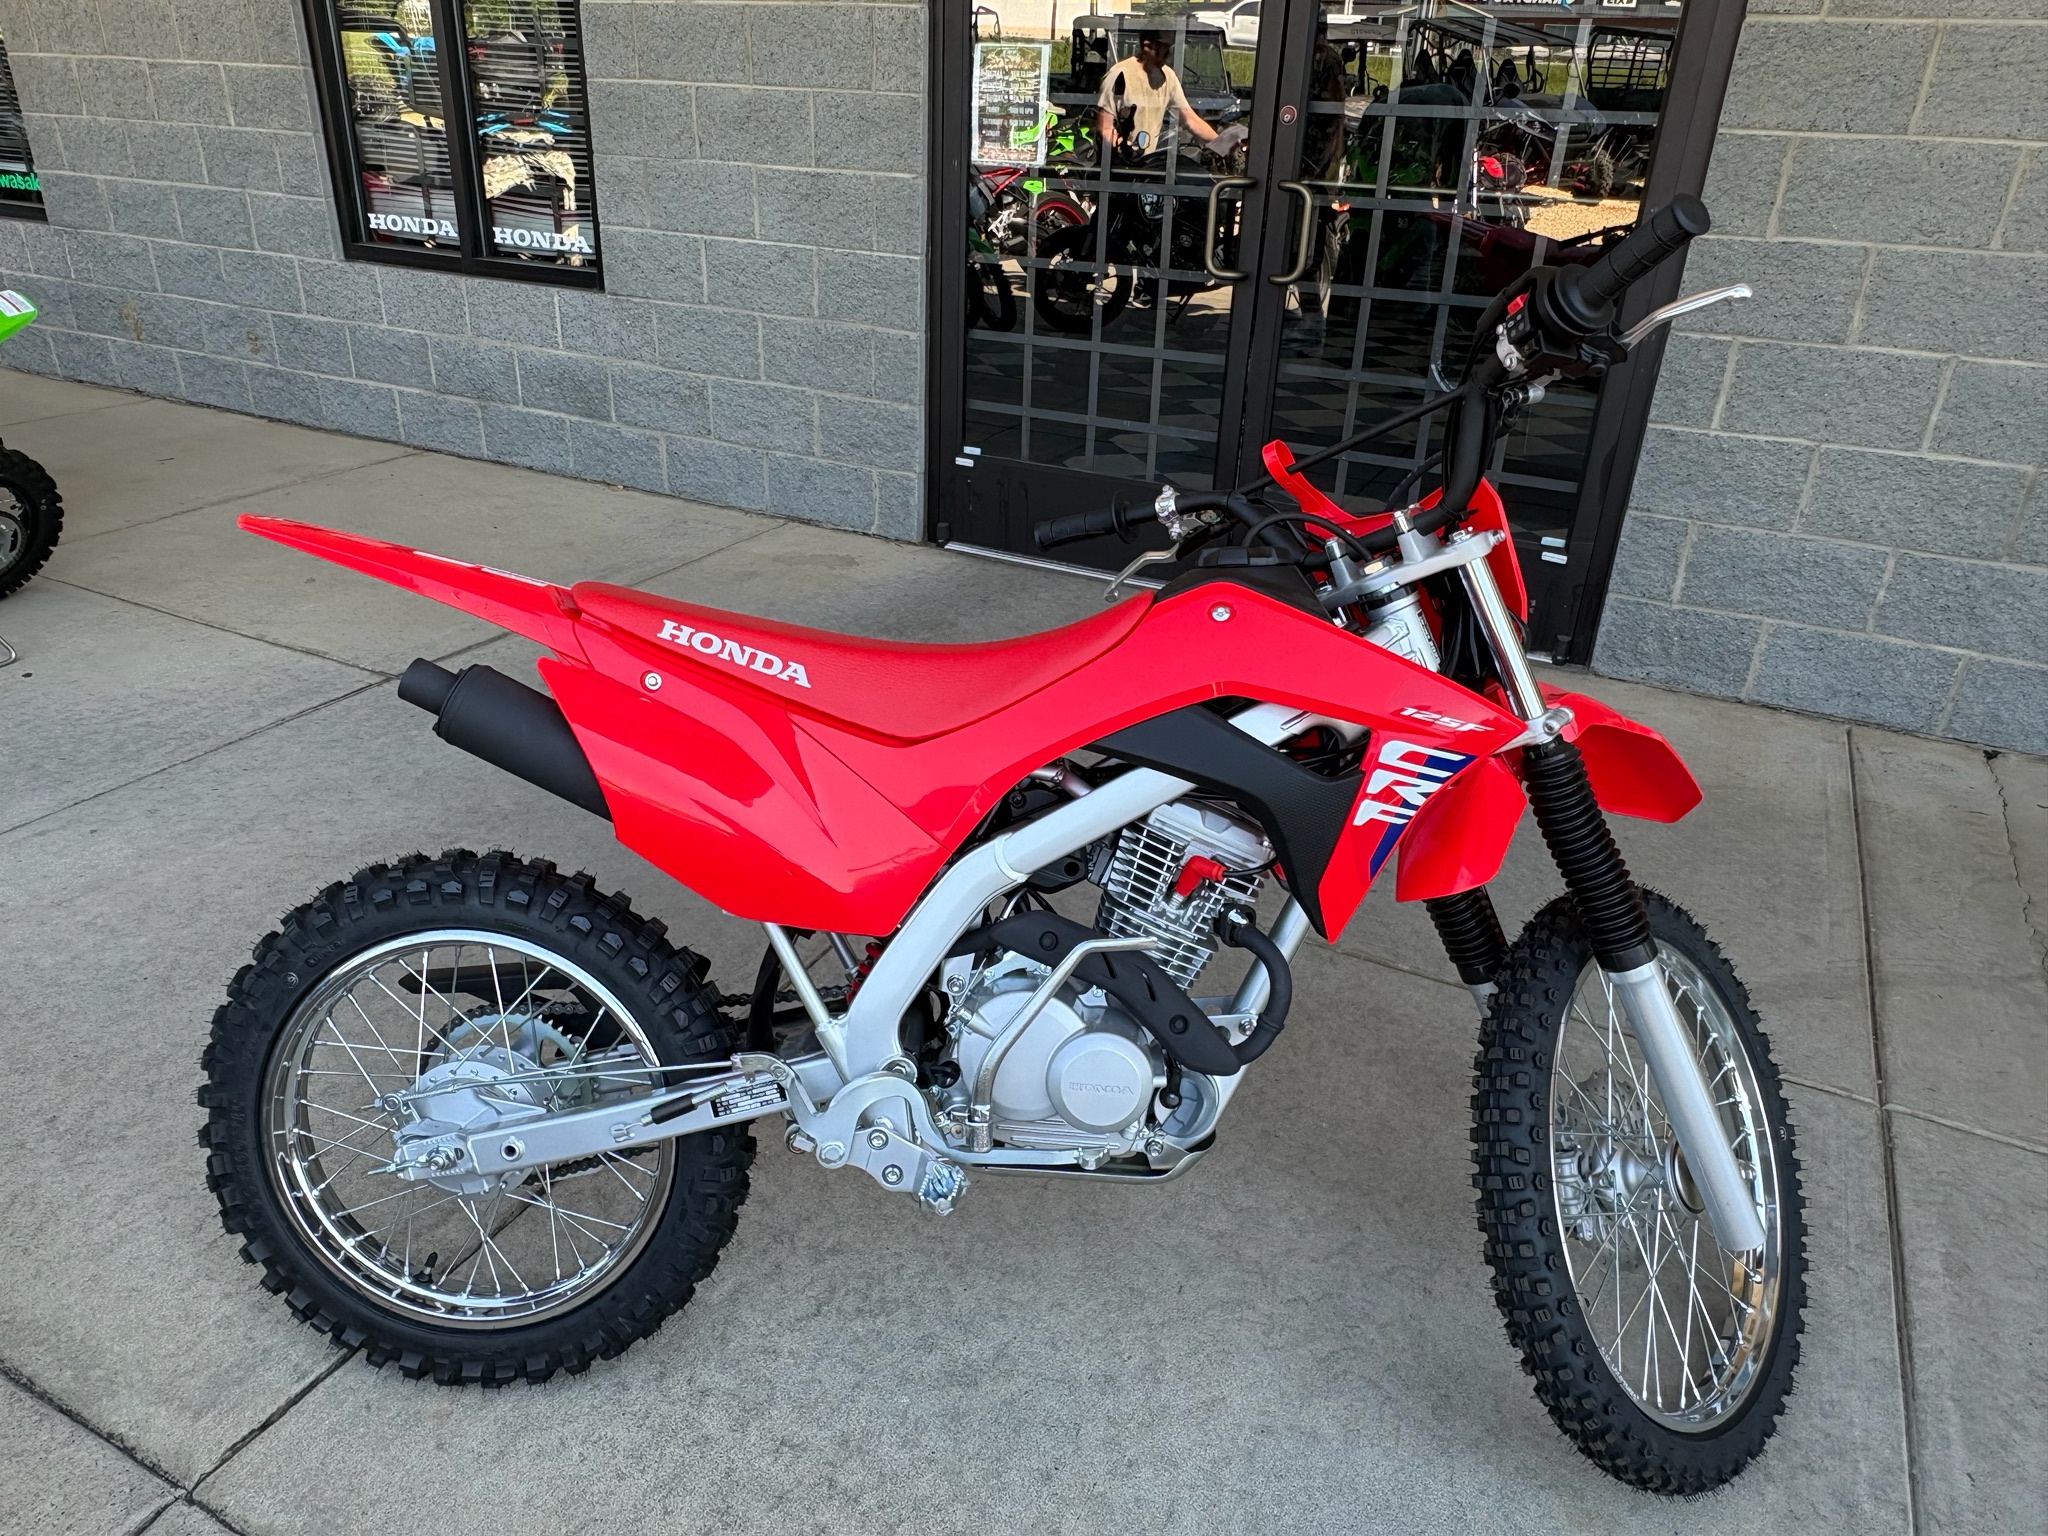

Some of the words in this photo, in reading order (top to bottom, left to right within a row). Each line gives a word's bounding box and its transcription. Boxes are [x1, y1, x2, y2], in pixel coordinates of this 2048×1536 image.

[368, 213, 458, 238] HONDA
[492, 226, 593, 253] HONDA
[656, 619, 812, 689] HONDA
[1399, 706, 1496, 732] 125F
[1352, 740, 1467, 826] CRF
[1068, 1081, 1135, 1095] HONDA
